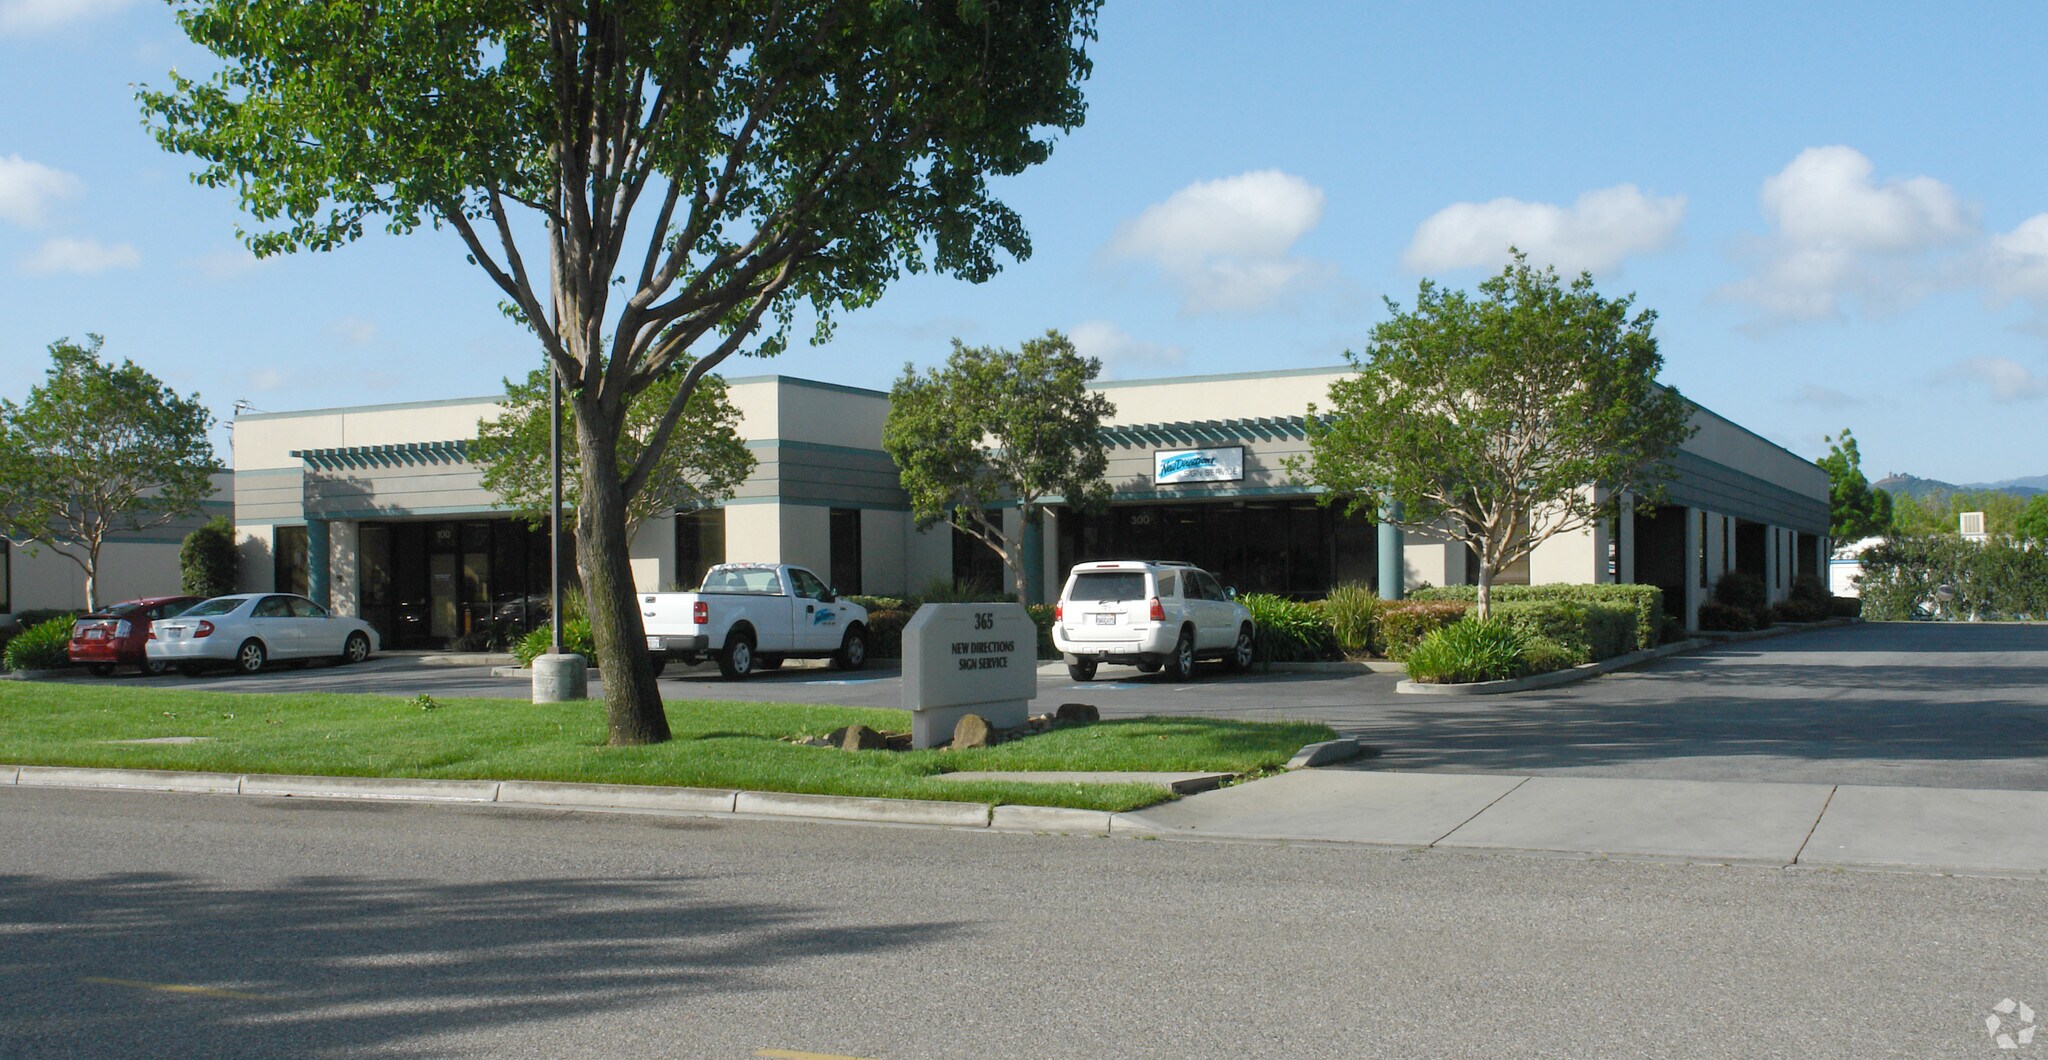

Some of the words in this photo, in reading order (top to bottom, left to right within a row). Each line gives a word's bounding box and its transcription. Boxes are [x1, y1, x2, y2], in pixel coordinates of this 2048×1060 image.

[1160, 462, 1175, 476] New
[1183, 468, 1203, 478] SIGN
[1205, 467, 1238, 477] SERVICE
[1130, 515, 1150, 525] 300
[974, 612, 994, 630] 365
[951, 642, 969, 655] NEW
[970, 640, 1015, 654] DIRECTIONS
[958, 658, 977, 671] SIGN
[978, 656, 1008, 670] SERVICE
